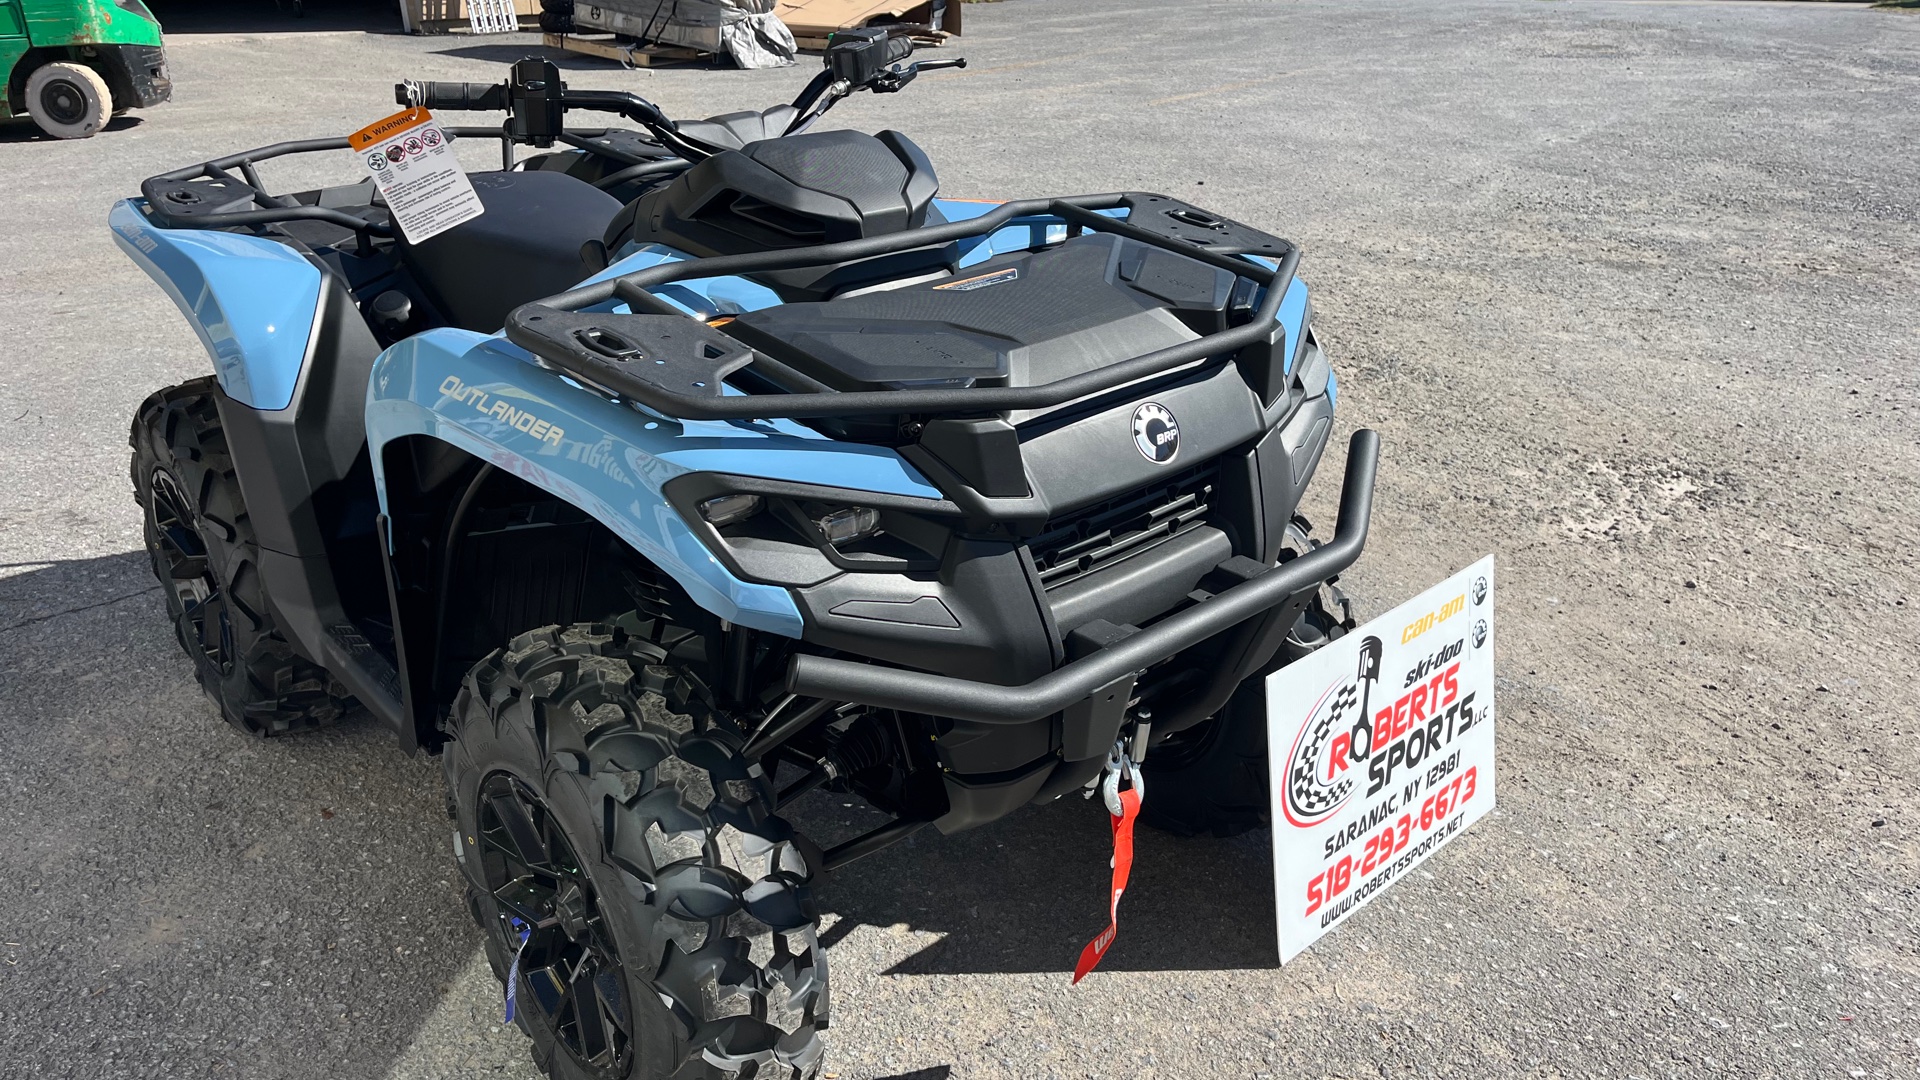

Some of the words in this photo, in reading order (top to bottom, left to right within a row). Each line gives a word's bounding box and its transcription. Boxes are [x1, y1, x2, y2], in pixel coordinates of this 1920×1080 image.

[438, 375, 565, 447] OUTLANDER
[1156, 428, 1177, 446] BRP
[1401, 593, 1465, 646] can-am
[1403, 638, 1464, 689] ski-doo
[1327, 661, 1461, 781] ROBERTS
[1305, 765, 1477, 918] 518-293-6673
[1323, 792, 1399, 861] SARANAC,
[1403, 775, 1423, 807] NY
[1426, 748, 1461, 790] 12981
[1320, 811, 1465, 929] WWW.ROBERTSSPORTS.NET
